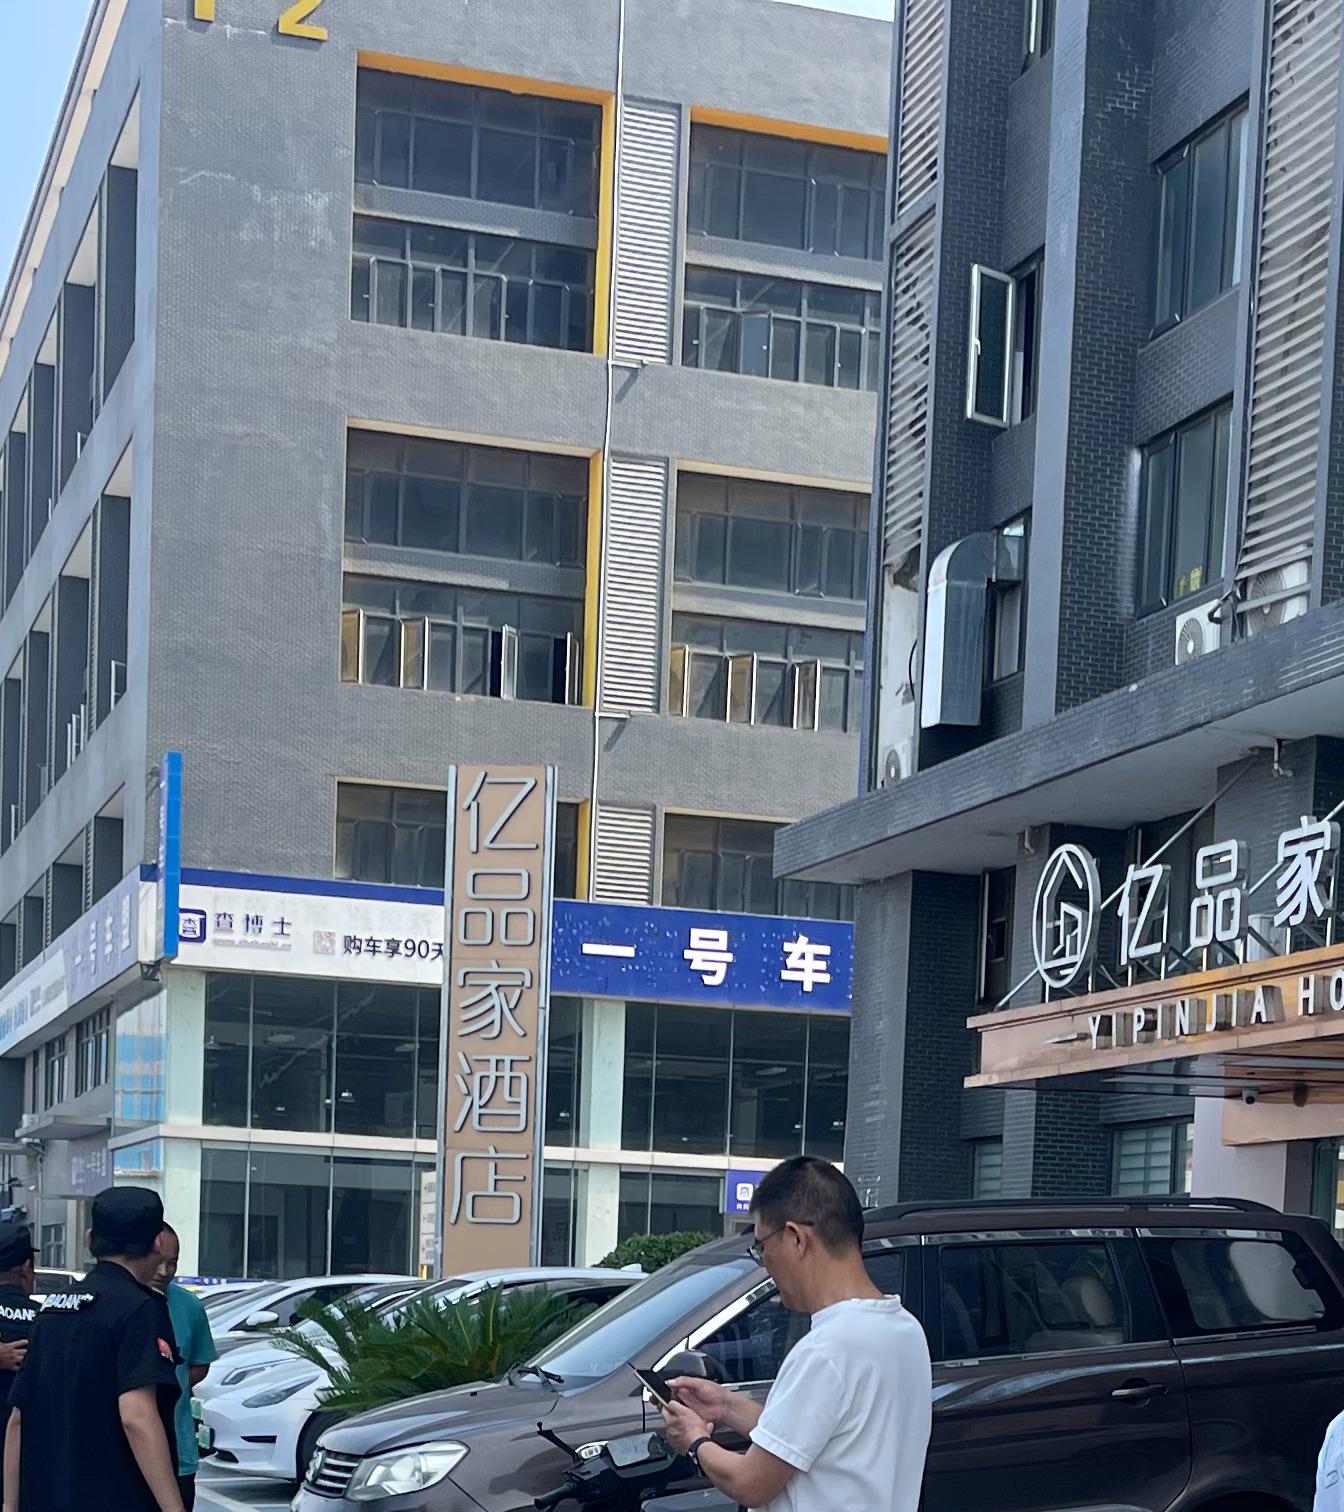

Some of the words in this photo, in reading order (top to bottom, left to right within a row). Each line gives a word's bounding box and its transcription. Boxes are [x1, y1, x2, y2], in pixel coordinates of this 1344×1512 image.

[215, 912, 292, 937] 查博士
[582, 927, 832, 992] 一号车
[450, 770, 538, 1226] 亿品家酒店
[1088, 983, 1278, 1050] YIPINJIA
